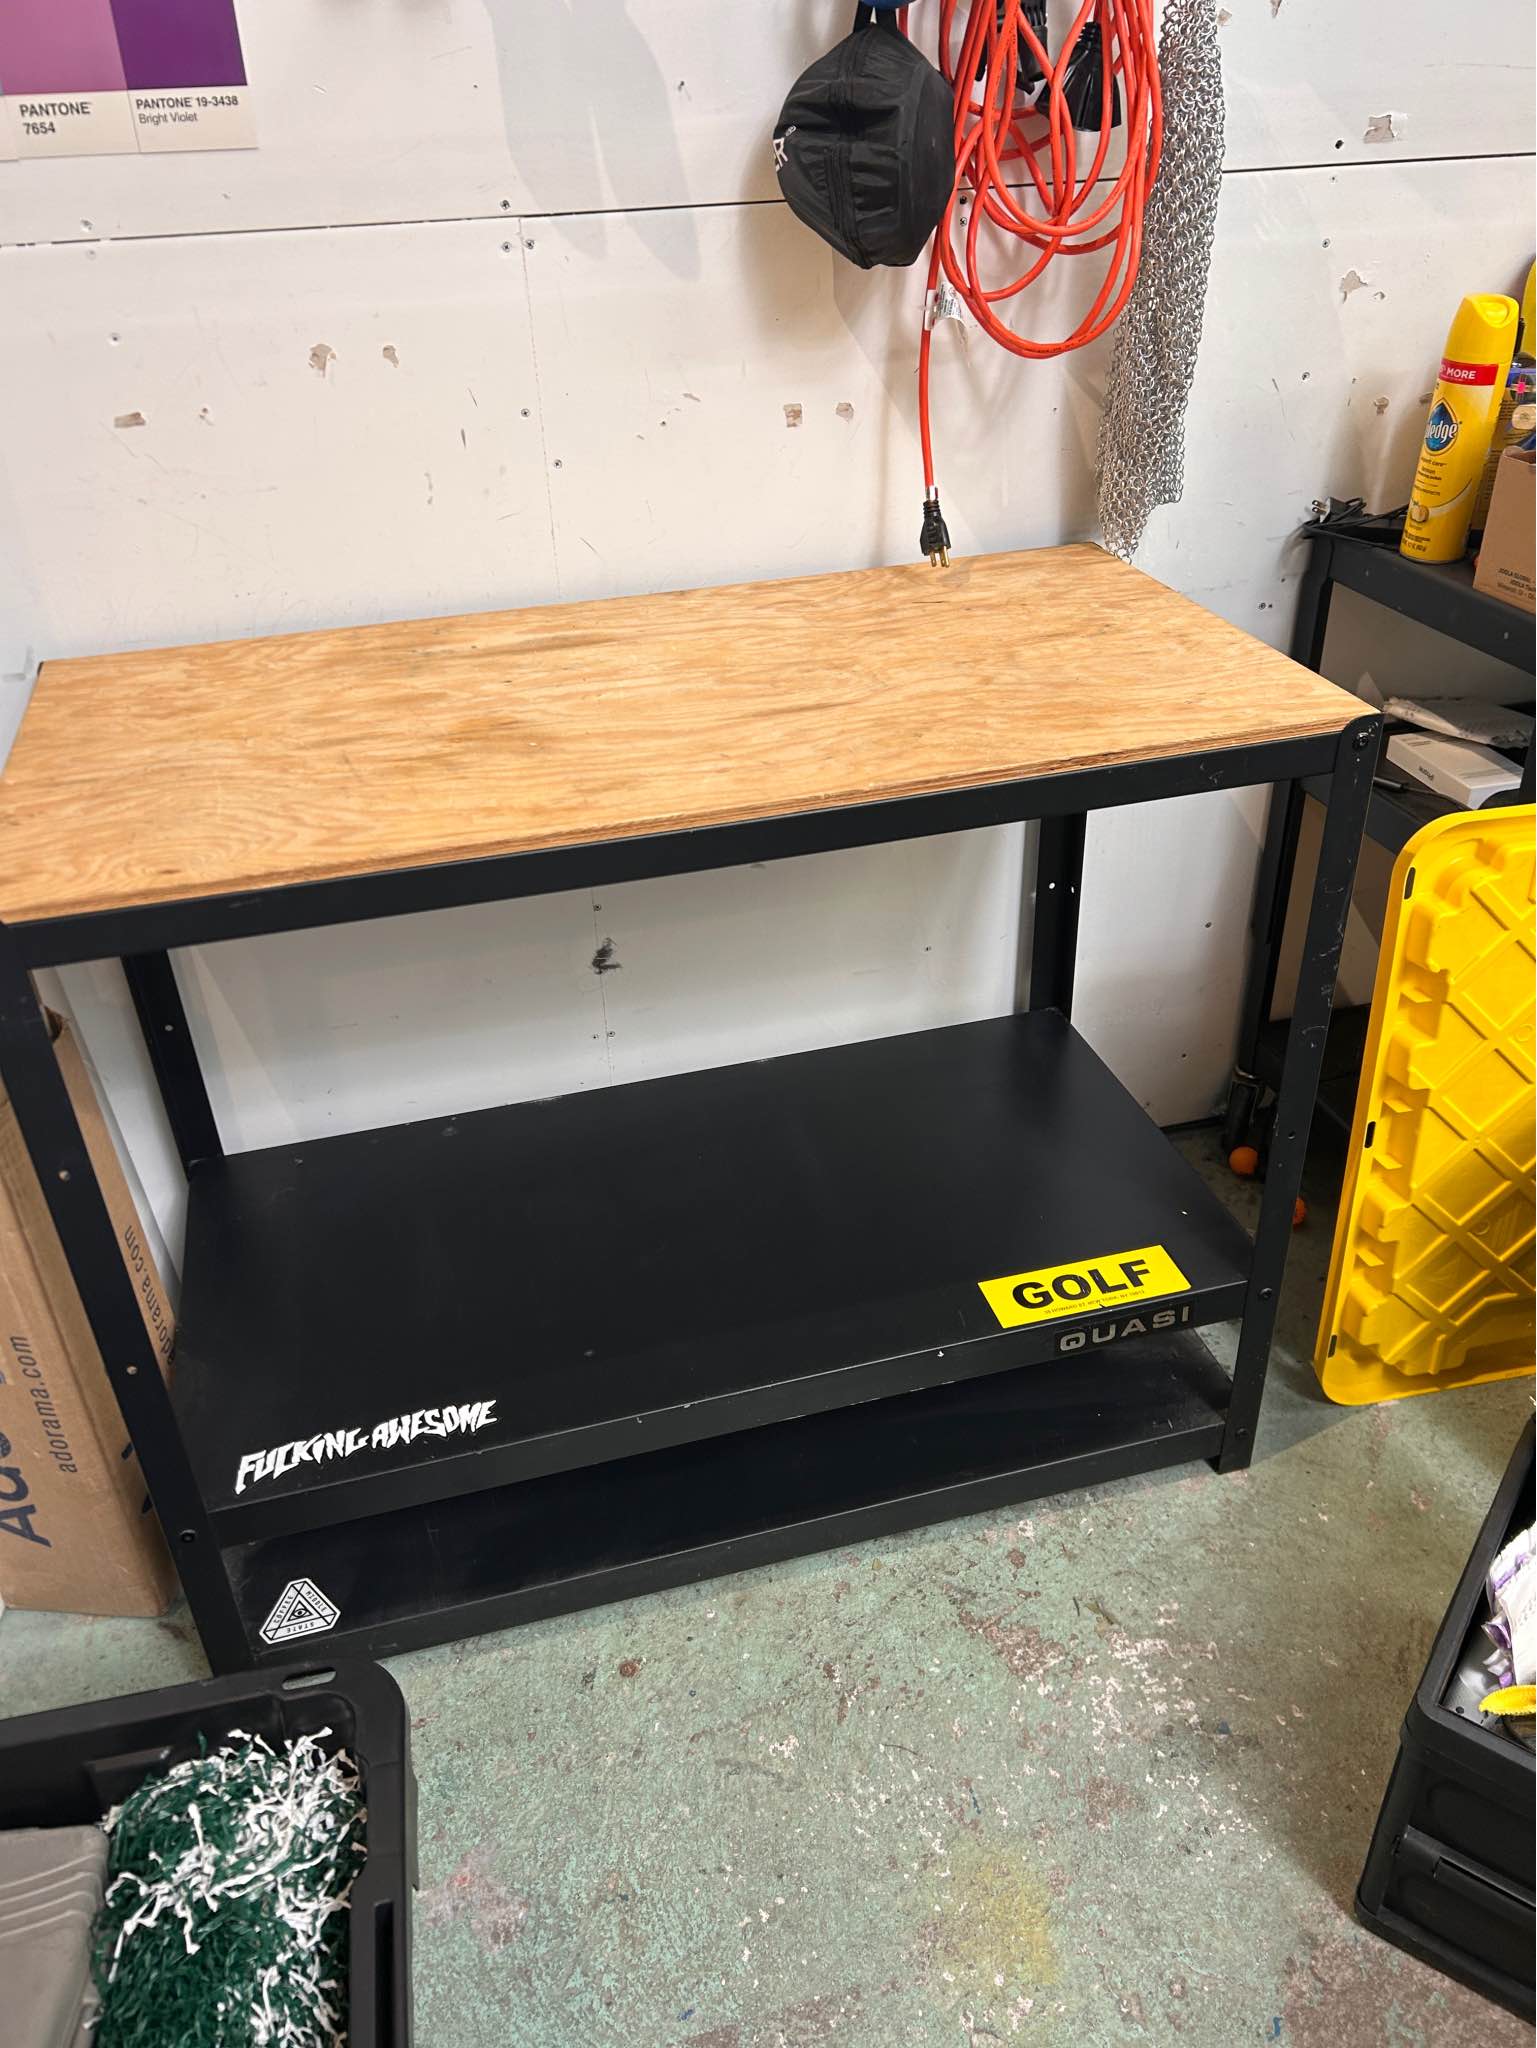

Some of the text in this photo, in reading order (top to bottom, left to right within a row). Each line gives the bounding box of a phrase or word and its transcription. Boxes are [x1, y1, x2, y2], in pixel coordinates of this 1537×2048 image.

[19, 102, 90, 117] PANTONE
[136, 95, 239, 109] PANTONE 19-3438
[23, 122, 56, 135] 7654
[139, 112, 198, 125] Bright Violet
[1446, 367, 1477, 380] MORE
[1424, 420, 1458, 443] ledge
[125, 1225, 176, 1365] adorama.com
[1012, 1259, 1151, 1310] GOLF
[1060, 1305, 1191, 1351] QUASI
[10, 1336, 78, 1473] adorama.com
[235, 1400, 497, 1495] FUCKING AWESOME
[273, 1595, 294, 1624] COFFEE
[306, 1590, 328, 1613] MIDDLE
[287, 1621, 315, 1633] STATE
